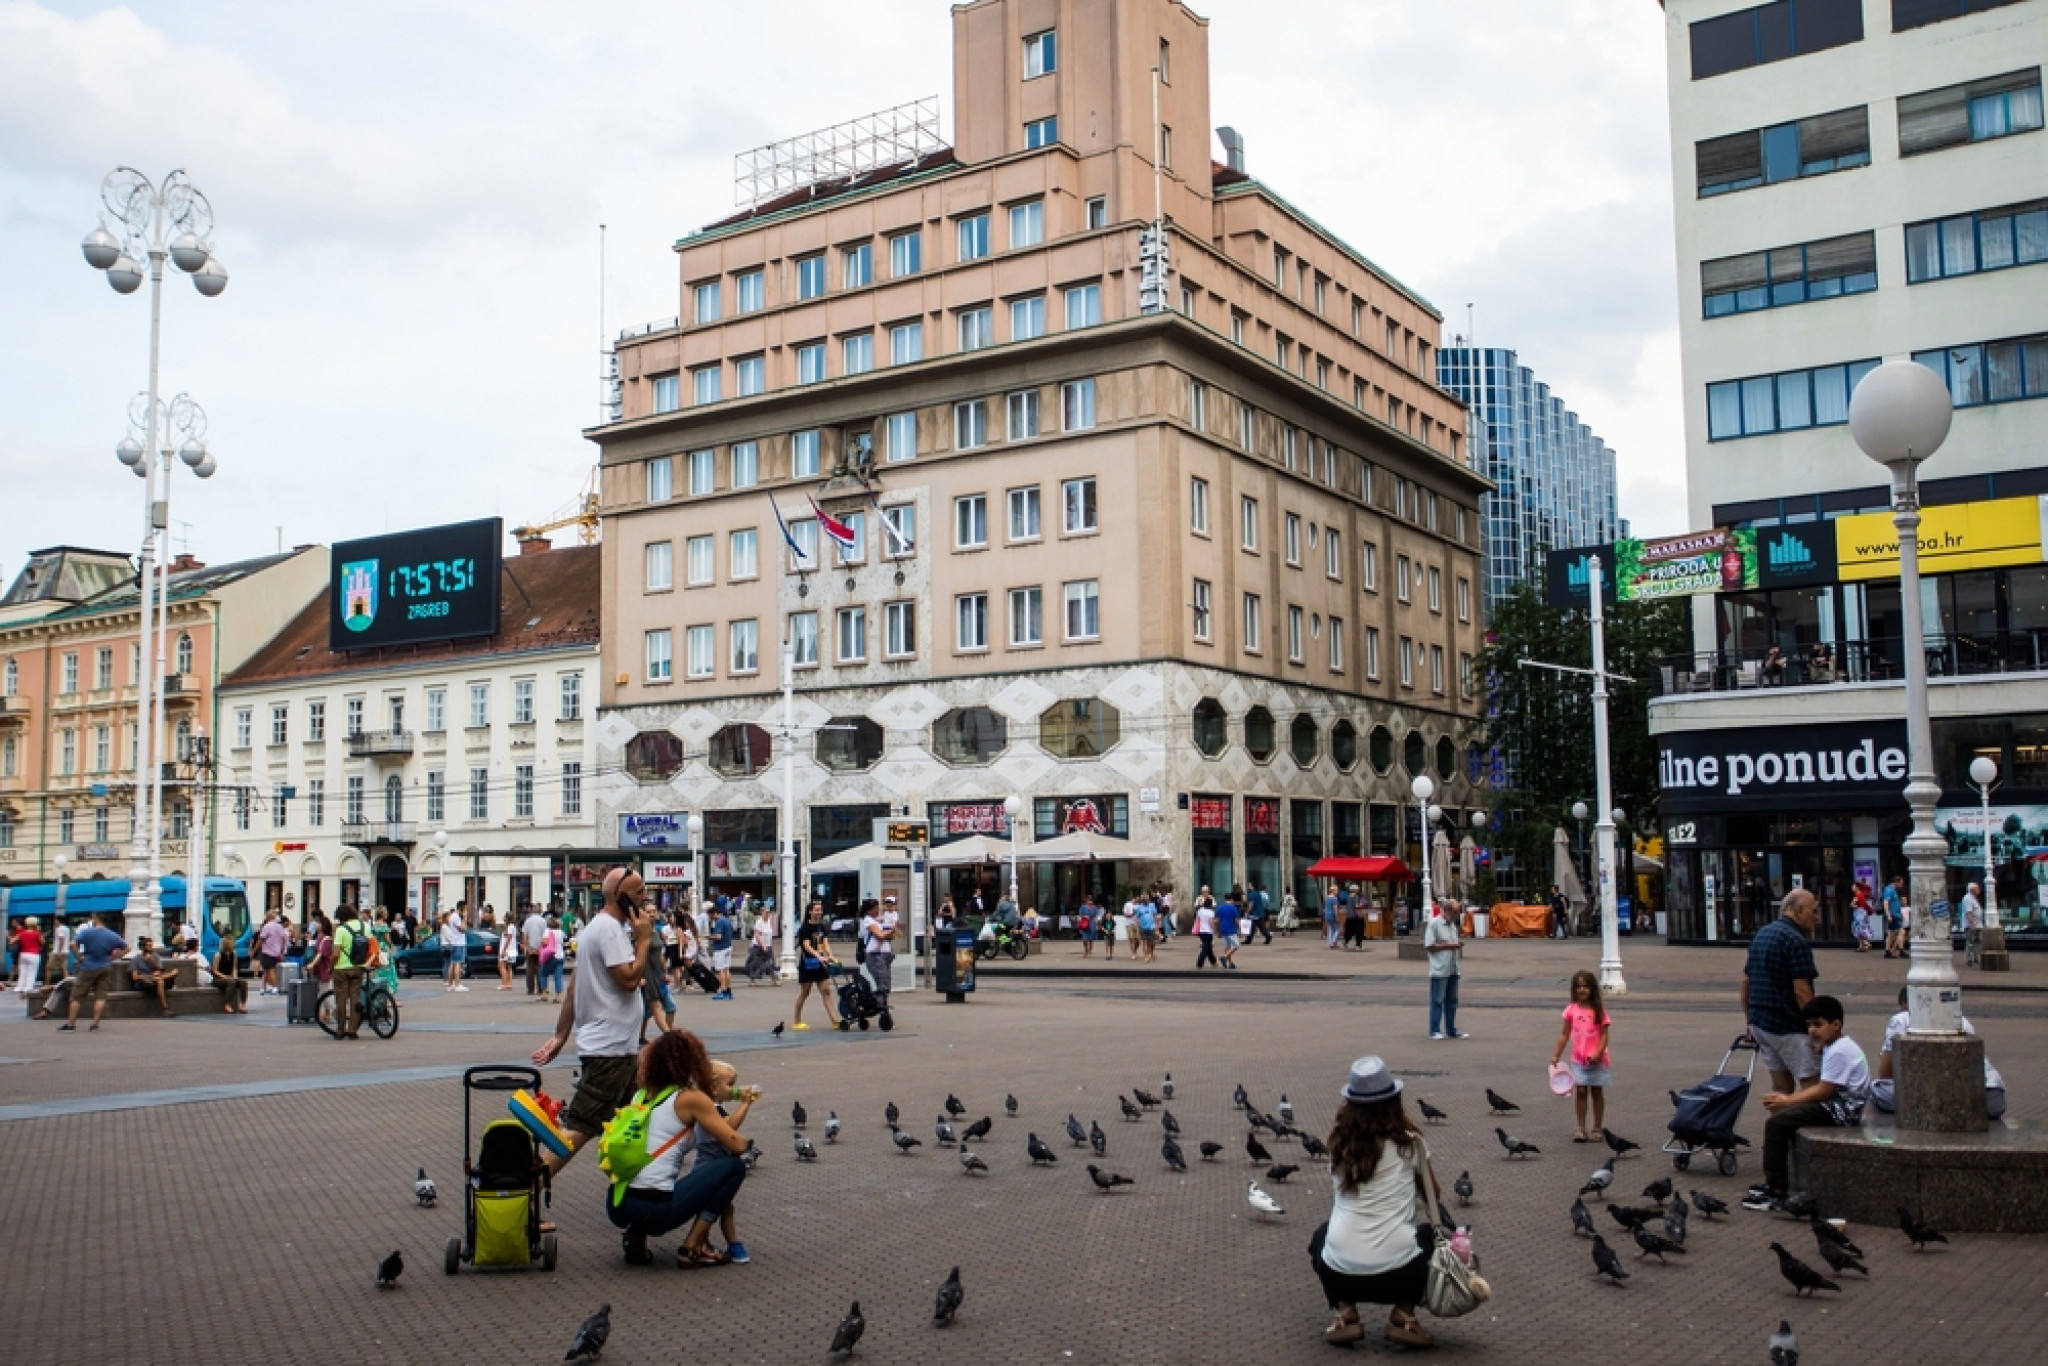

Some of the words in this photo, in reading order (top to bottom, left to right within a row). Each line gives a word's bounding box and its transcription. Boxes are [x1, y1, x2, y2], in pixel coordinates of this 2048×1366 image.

[389, 558, 474, 598] 17:57:51
[1649, 559, 1709, 581] PRIRODA
[1674, 569, 1723, 592] GRADA
[407, 601, 450, 620] ZAGREB
[1725, 738, 1907, 795] ponude
[654, 865, 685, 878] TISAK
